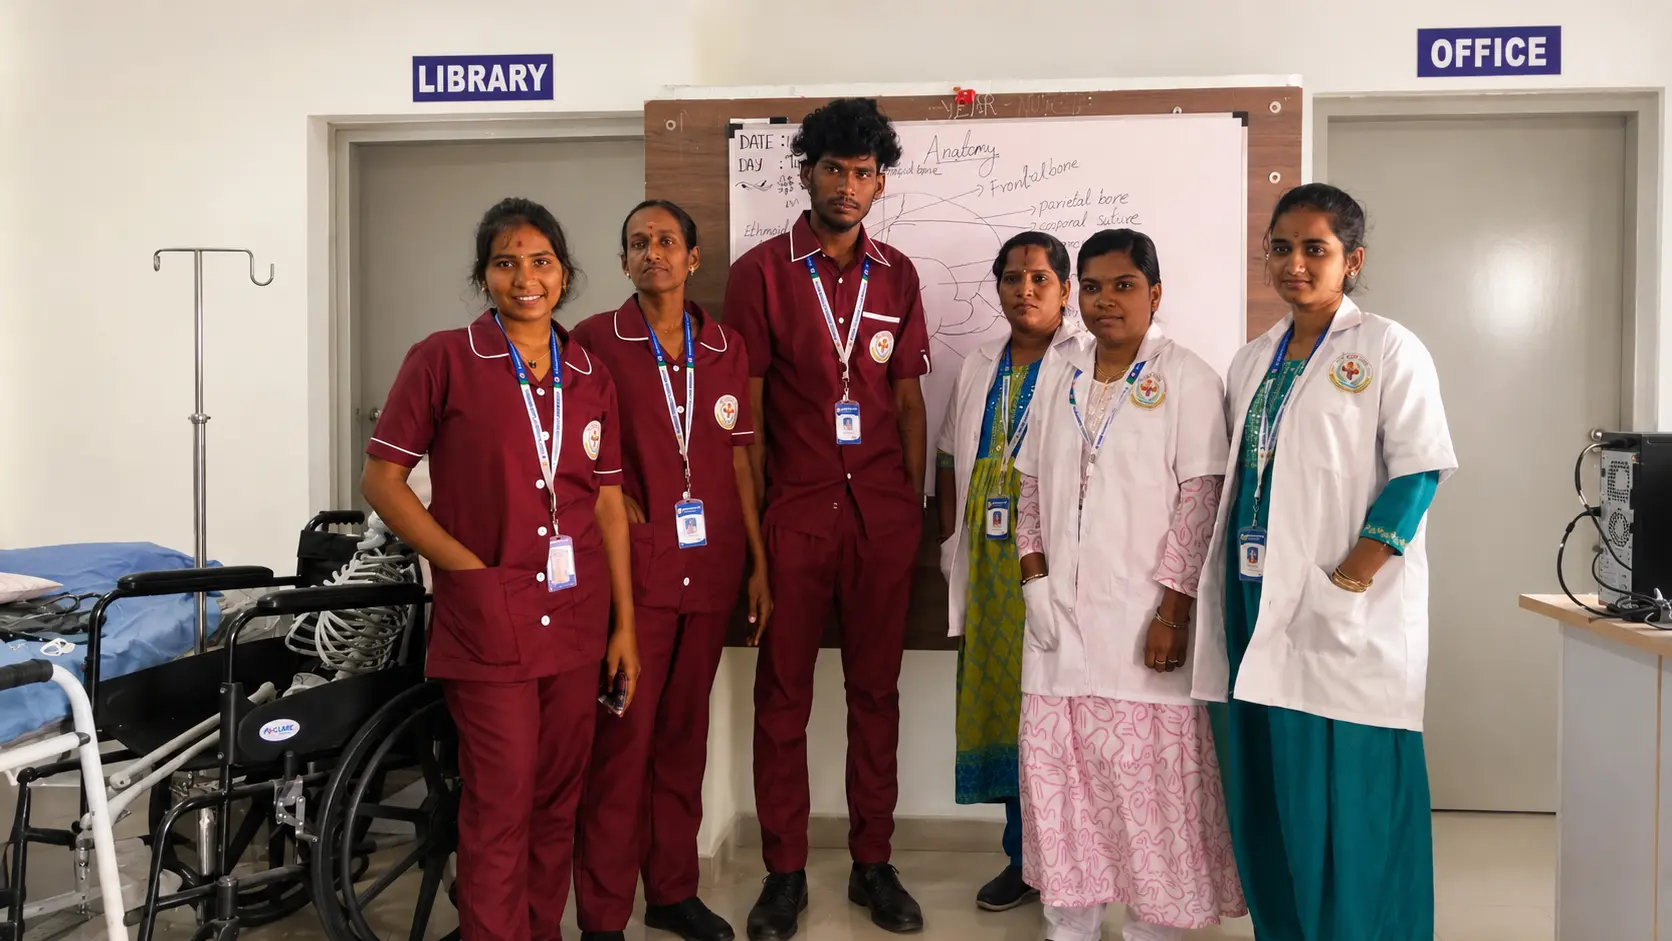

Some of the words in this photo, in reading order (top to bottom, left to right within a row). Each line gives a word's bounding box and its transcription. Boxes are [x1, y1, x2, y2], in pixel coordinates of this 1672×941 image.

[1431, 37, 1547, 69] OFFICE
[419, 64, 548, 93] LIBRARY
[739, 134, 774, 150] DATE
[924, 129, 998, 178] Anatomy
[738, 157, 764, 172] DAY
[1038, 188, 1092, 218] parietal
[743, 219, 790, 238] Ethmoid
[1096, 206, 1143, 227] suture
